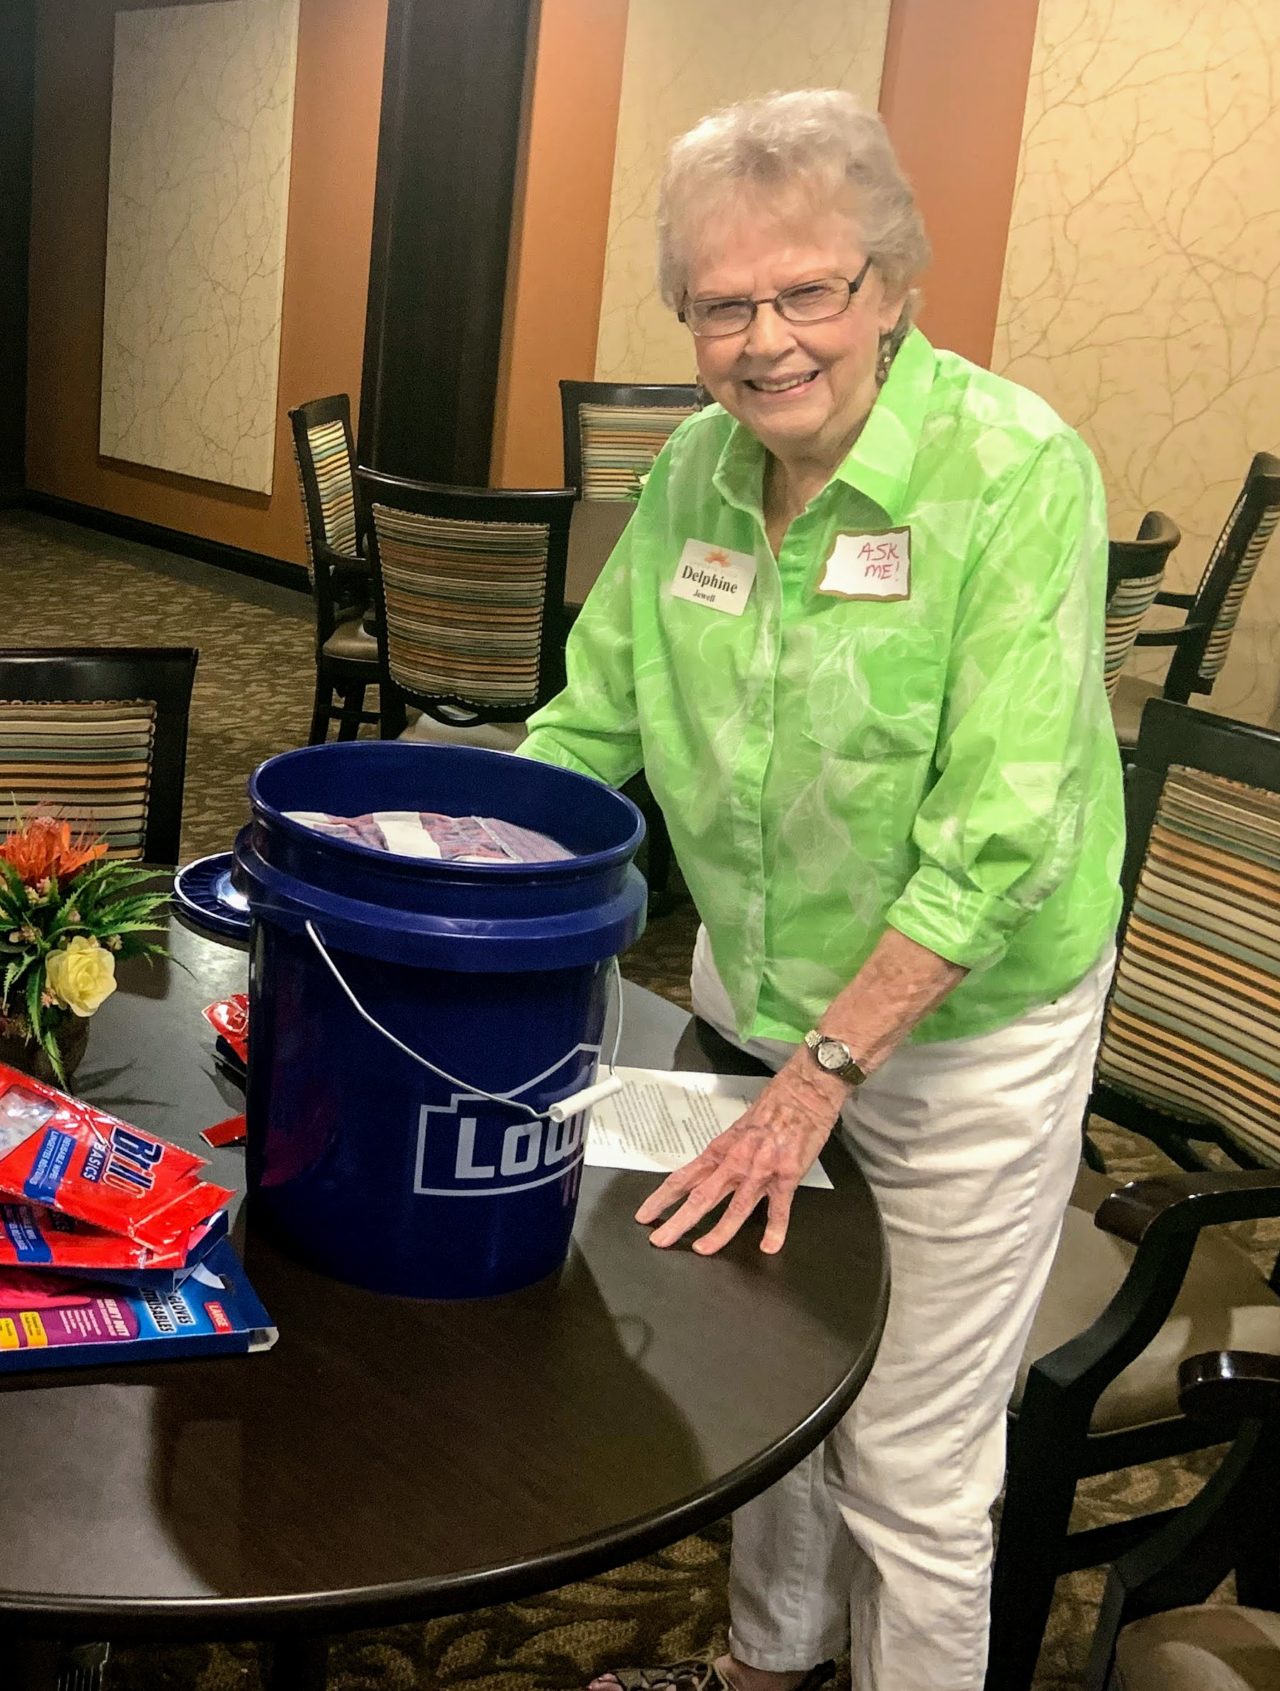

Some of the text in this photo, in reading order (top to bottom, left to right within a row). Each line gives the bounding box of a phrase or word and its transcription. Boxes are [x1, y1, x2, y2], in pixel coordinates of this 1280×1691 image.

[857, 542, 900, 561] ASK
[682, 565, 738, 594] Delphine
[864, 561, 900, 582] ME!
[693, 589, 716, 602] Jewell
[82, 1142, 106, 1181] BASICS
[103, 1126, 165, 1199] Brillo
[167, 1294, 193, 1325] GLOVES
[208, 1304, 228, 1327] LARGE
